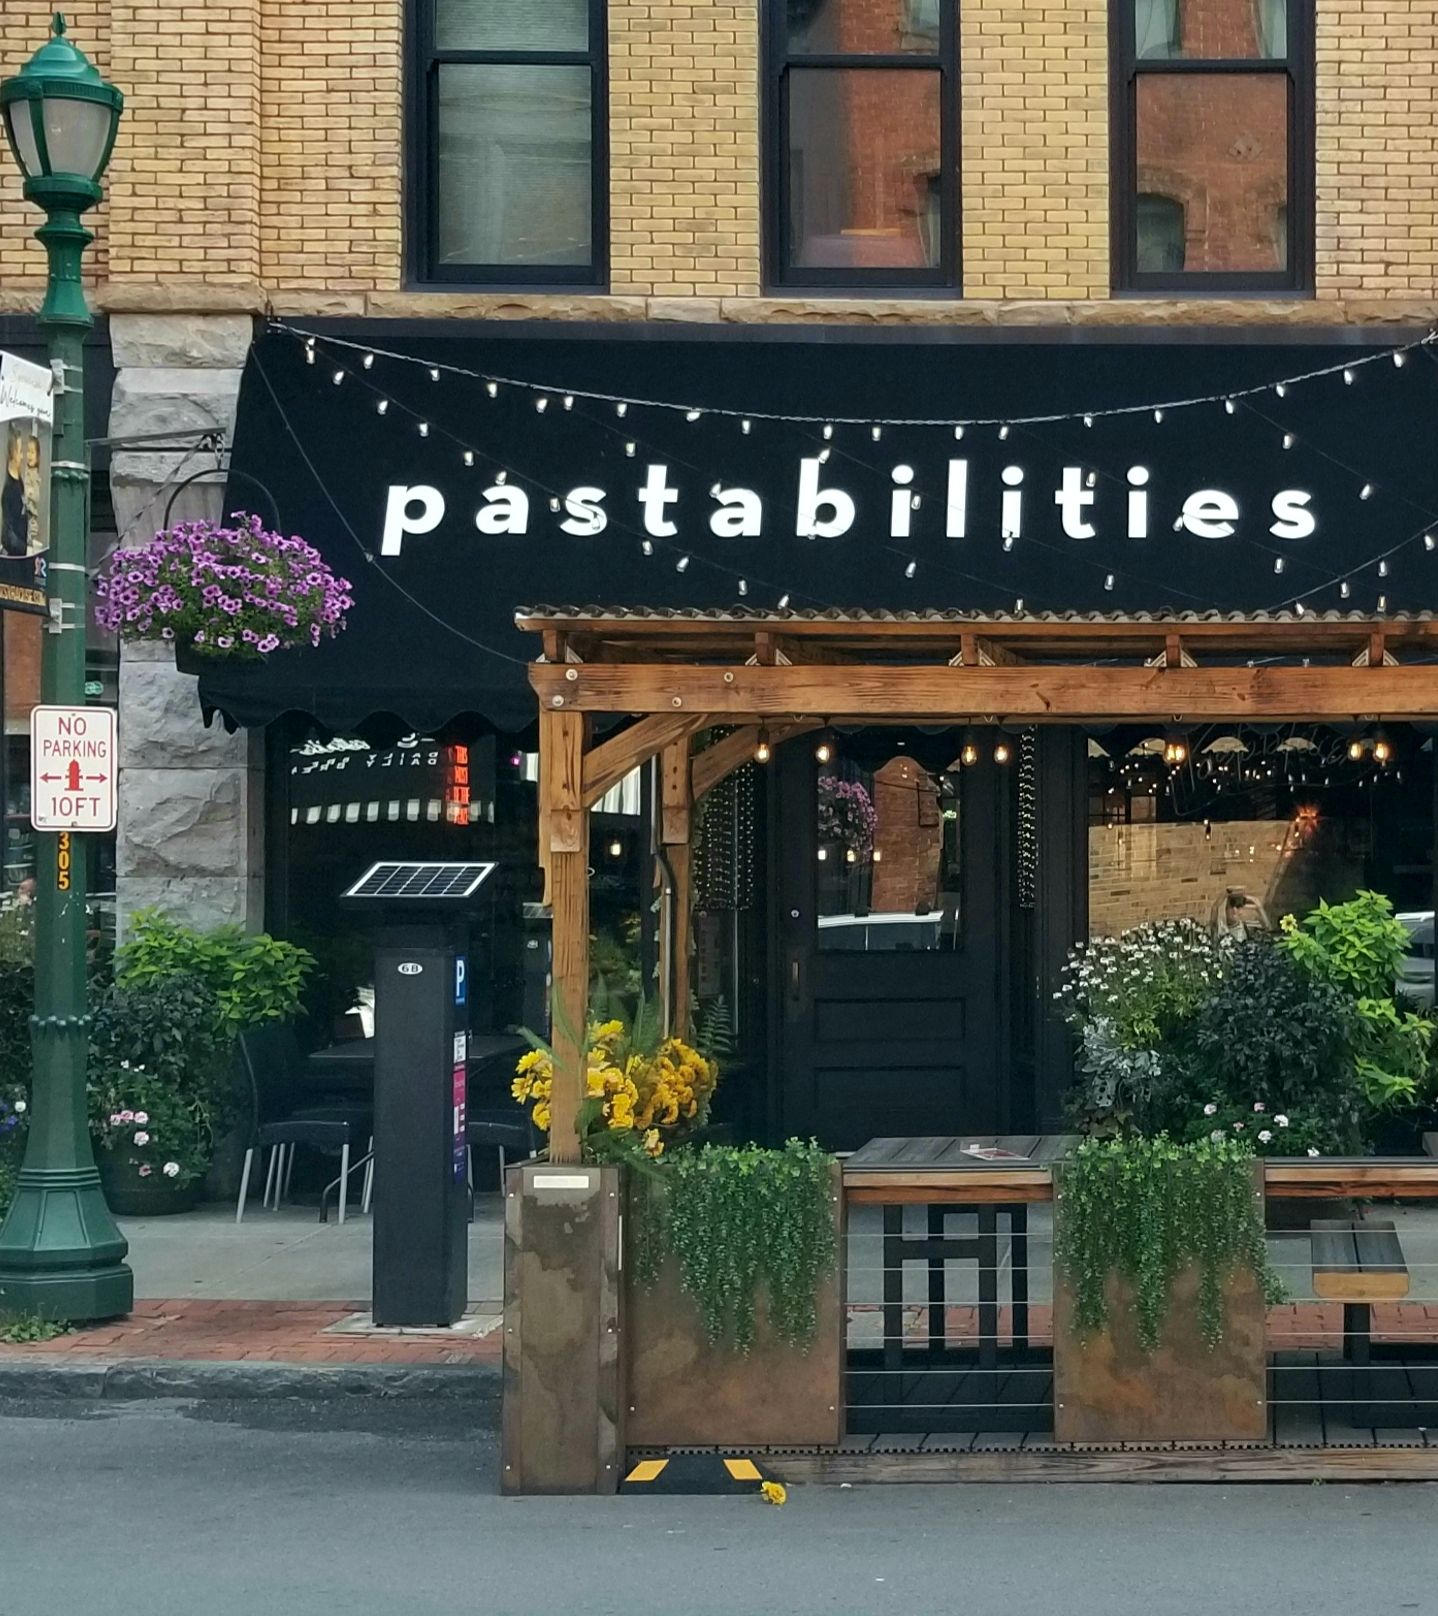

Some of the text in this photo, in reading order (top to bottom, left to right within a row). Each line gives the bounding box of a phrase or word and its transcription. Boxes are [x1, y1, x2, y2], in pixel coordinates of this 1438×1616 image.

[381, 458, 1316, 556] pastabilities
[58, 717, 86, 735] NO
[43, 740, 106, 758] PARKING
[51, 797, 100, 817] 10FT
[58, 832, 69, 890] 305
[456, 959, 465, 997] P
